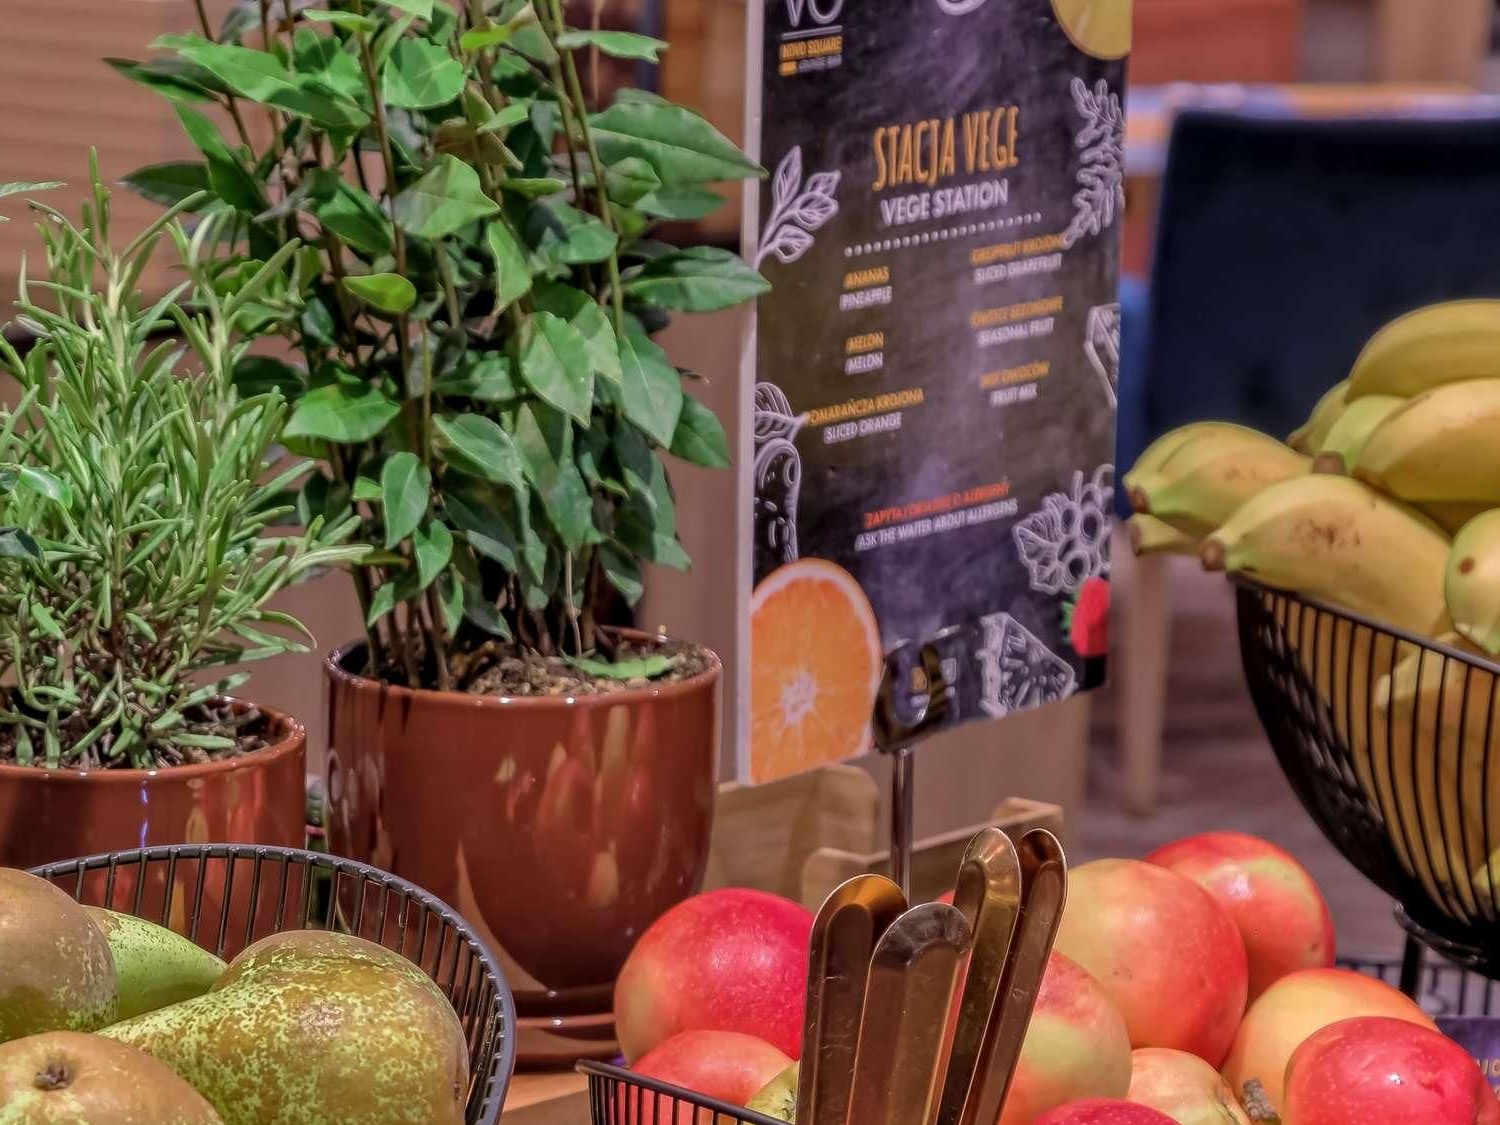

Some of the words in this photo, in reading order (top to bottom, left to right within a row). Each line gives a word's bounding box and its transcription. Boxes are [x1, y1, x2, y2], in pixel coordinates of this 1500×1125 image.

[871, 117, 955, 192] STACJA
[963, 105, 1019, 175] VEGE
[880, 192, 931, 228] VEGE
[932, 178, 1009, 218] STATION
[843, 265, 890, 291] ANANAS
[840, 285, 892, 312] PINEAPPLE
[845, 331, 884, 354] MELON
[845, 352, 884, 375] MELON
[823, 422, 858, 444] SLICED
[858, 411, 902, 437] ORANGE
